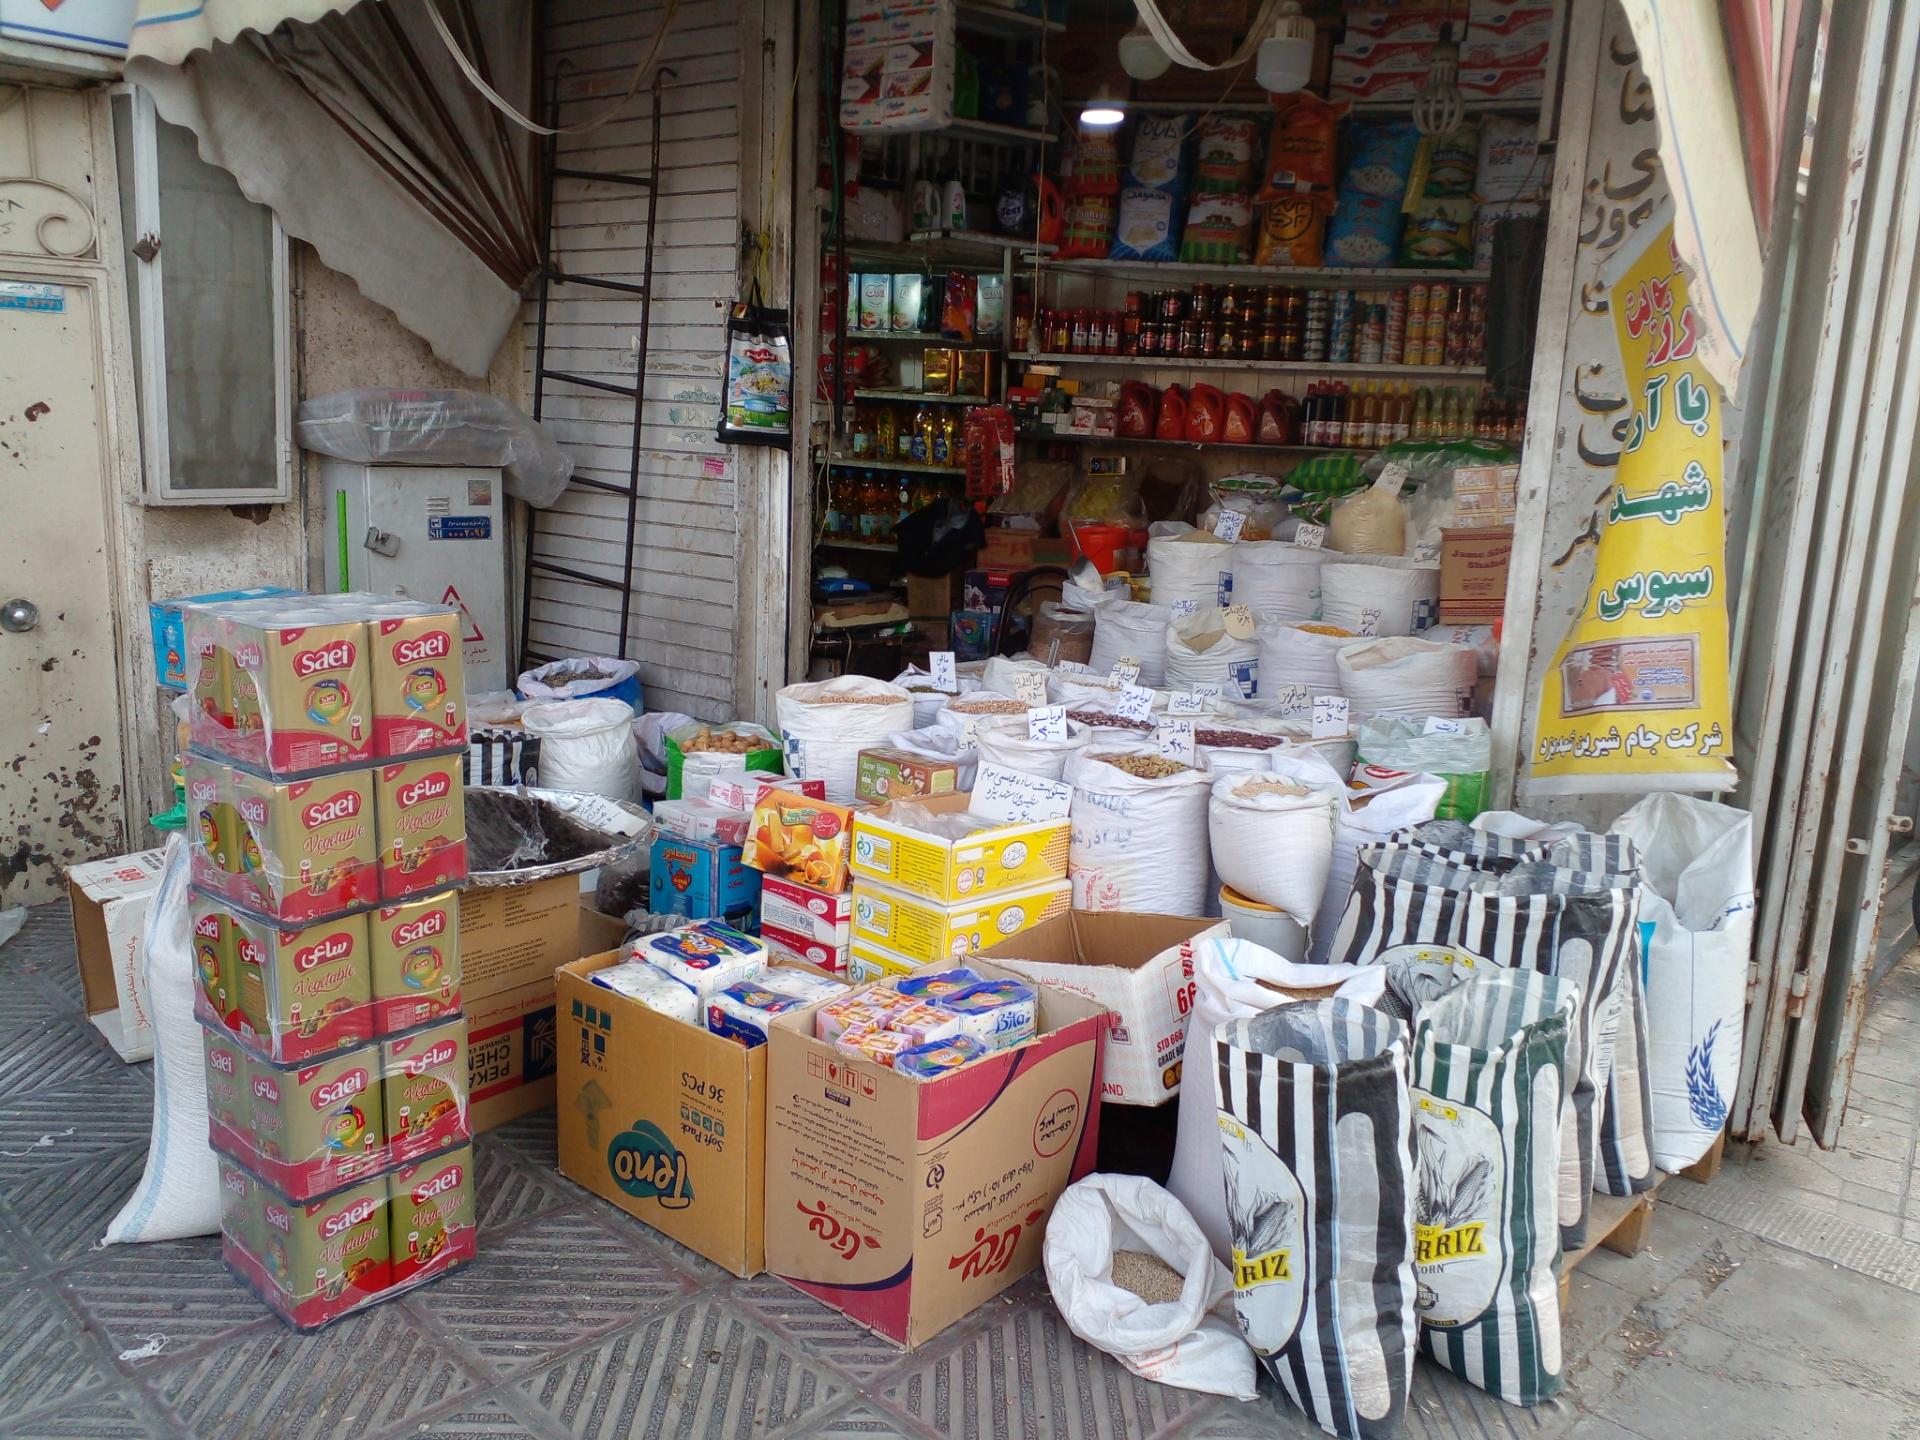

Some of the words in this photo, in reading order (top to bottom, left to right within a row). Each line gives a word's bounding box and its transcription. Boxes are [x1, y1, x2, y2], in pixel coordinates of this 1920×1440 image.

[1608, 460, 1712, 525] شهد
[1597, 566, 1713, 621] سبوس
[301, 644, 349, 674] Saei
[400, 635, 443, 663] Saei
[1574, 726, 1621, 758] شیرین
[1625, 724, 1661, 756] جام
[1666, 722, 1723, 756] شرکت
[192, 783, 216, 801] Saei
[402, 780, 445, 804] ساعی
[240, 801, 264, 822] Saei
[309, 797, 354, 824] Saei
[396, 803, 453, 832] Vegetable
[304, 824, 365, 854] Vegetable
[196, 920, 219, 938] Saei
[399, 914, 441, 943] Saei
[301, 940, 347, 968] ساعی
[293, 964, 354, 996] Vegetable
[1157, 1038, 1170, 1054] STD
[1170, 1029, 1184, 1045] 666
[210, 1051, 232, 1072] Saei
[409, 1047, 452, 1075] ساعی
[1158, 1048, 1176, 1067] GRADE
[468, 1061, 511, 1088] PEKA
[681, 1072, 705, 1096] PCS
[317, 1073, 362, 1106] Saei
[709, 1085, 725, 1103] 36
[681, 1122, 703, 1143] Pack
[703, 1134, 724, 1152] Soft
[417, 1169, 457, 1202] Saei
[614, 1149, 690, 1209] Teno
[266, 1208, 289, 1230] Saei
[325, 1202, 375, 1238] Saei
[963, 1200, 997, 1222] دستمال
